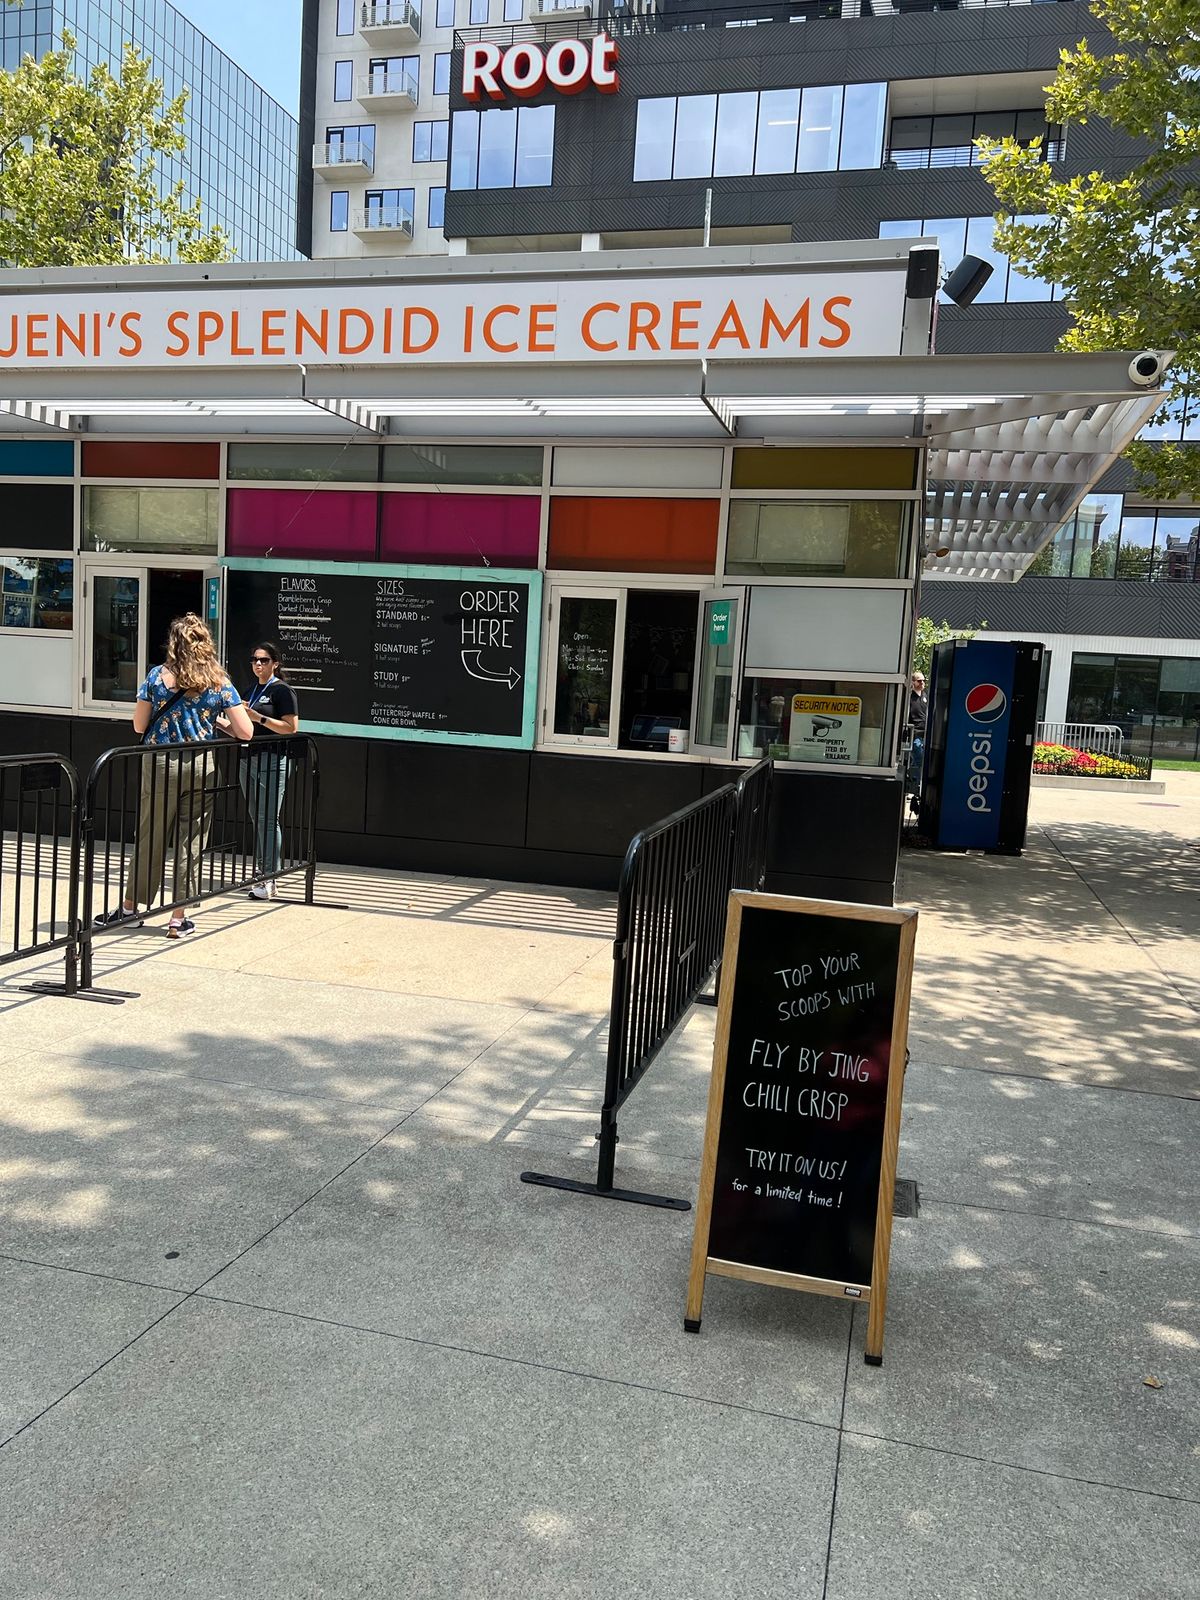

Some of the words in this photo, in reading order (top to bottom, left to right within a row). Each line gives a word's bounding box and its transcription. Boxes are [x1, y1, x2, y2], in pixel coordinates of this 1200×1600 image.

[0, 311, 142, 358] JENI'S
[165, 306, 440, 357] SPLENDID
[463, 303, 557, 353] ICE
[580, 295, 853, 352] CREAMS
[281, 577, 316, 591] FLAVORS
[376, 580, 405, 595] SIZES
[278, 603, 298, 612] Darkest
[299, 604, 323, 614] Chocolate
[459, 590, 520, 614] ORDER
[376, 609, 418, 621] STANDARD
[712, 613, 728, 622] Order
[461, 618, 514, 649] HERE
[713, 623, 725, 632] here
[280, 631, 297, 641] Salted
[312, 633, 332, 643] Butter
[374, 642, 419, 655] SIGNATURE
[373, 671, 399, 681] STUDY
[794, 700, 830, 711] SECURITY
[830, 702, 859, 712] NOTICE
[370, 708, 411, 718] BUTTERCRISP
[412, 711, 436, 719] WAFFLE
[372, 716, 390, 725] CONE
[400, 719, 417, 727] BOWL
[966, 732, 995, 813] pepsi
[774, 964, 813, 989] TOP
[820, 952, 861, 980] YOUR
[778, 990, 831, 1021] SCOOPS
[838, 982, 876, 1006] WITH
[750, 1038, 790, 1069] FLY
[798, 1047, 825, 1075] BY
[828, 1051, 870, 1083] JING
[742, 1081, 790, 1113] CHILI
[798, 1088, 849, 1122] CRISP
[745, 1147, 777, 1172] TRY
[779, 1152, 793, 1173] IT
[794, 1155, 817, 1177] ON
[818, 1160, 848, 1181] US!
[732, 1178, 749, 1192] for
[754, 1185, 762, 1196] a
[766, 1182, 803, 1203] limited
